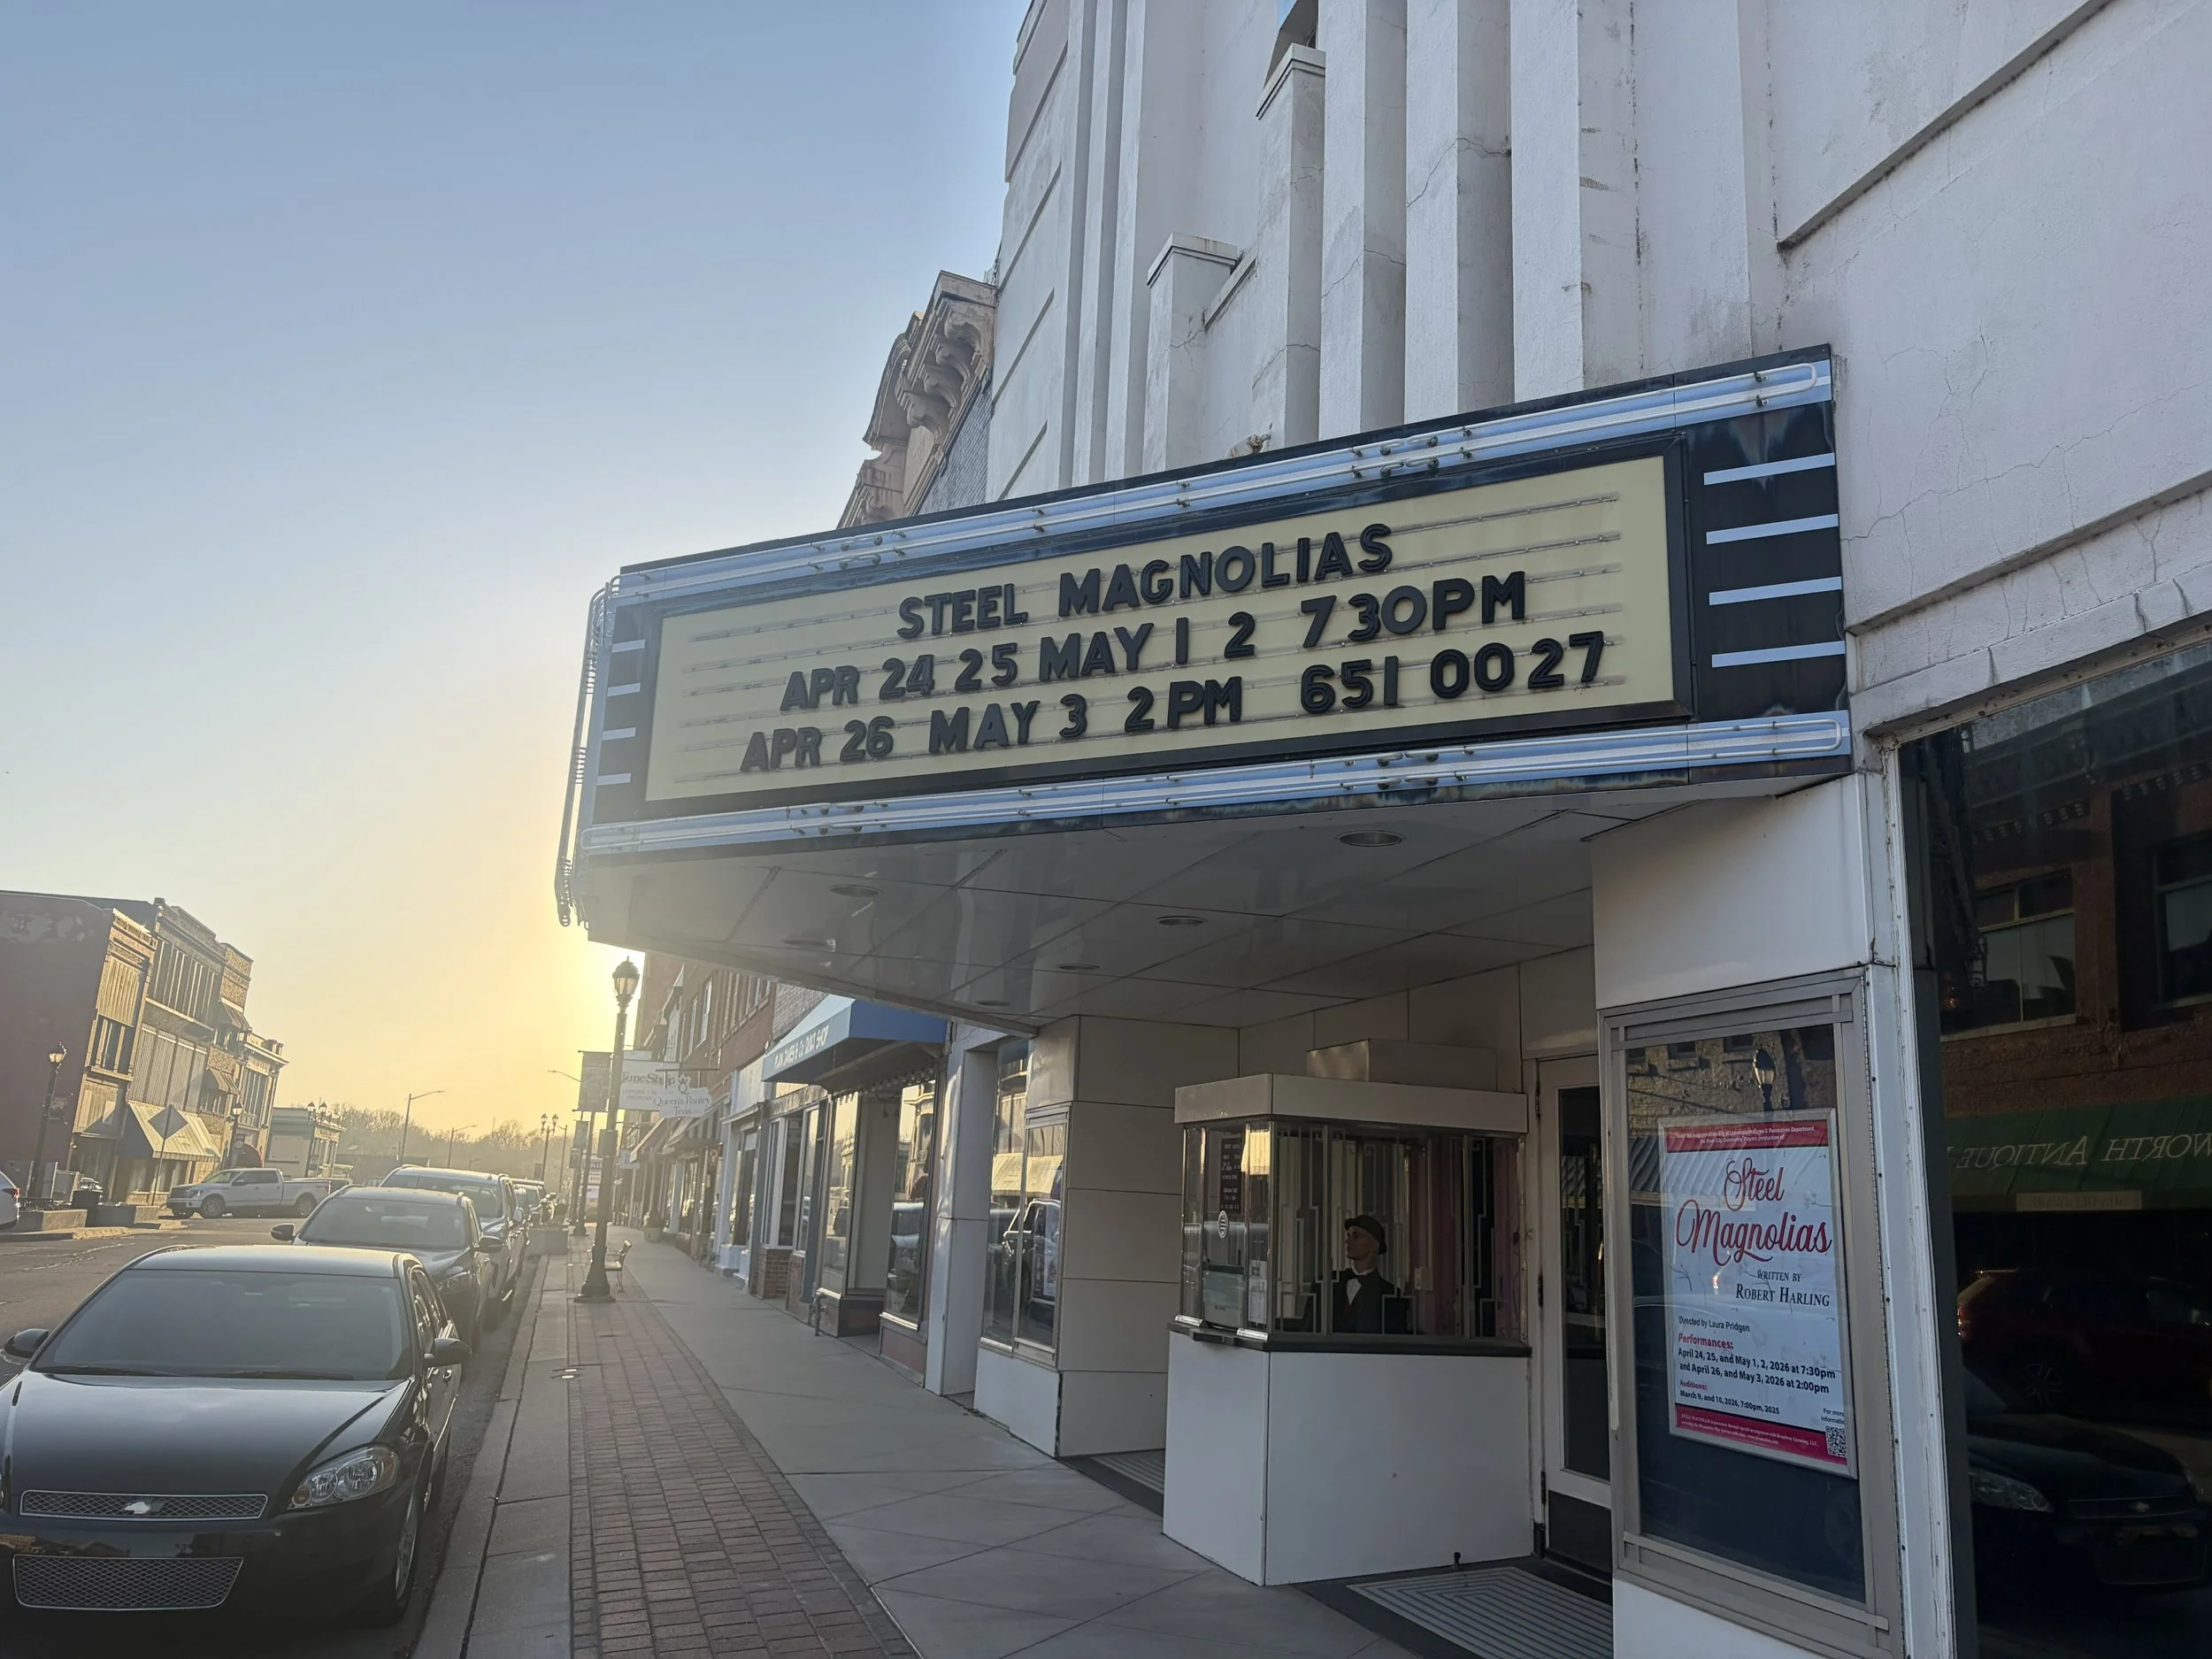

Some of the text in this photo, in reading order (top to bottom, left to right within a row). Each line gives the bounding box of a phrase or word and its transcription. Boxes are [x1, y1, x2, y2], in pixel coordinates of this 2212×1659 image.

[895, 523, 1393, 640] STEEL MAGNOLIAS
[780, 665, 860, 711] APR
[879, 654, 935, 701] 24
[958, 642, 1018, 692] 25
[1039, 623, 1153, 681] MAY
[1224, 611, 1256, 659] 2
[740, 726, 822, 773] APR
[839, 716, 895, 763] 26
[928, 700, 1042, 756] MAY
[1059, 694, 1087, 739] 3
[1300, 656, 1400, 713] 651
[1724, 1157, 1785, 1211] Steel
[1676, 1199, 1832, 1266] Magnolias
[1757, 1269, 1802, 1282] WRITTEN BY
[1678, 1316, 1750, 1333] Directed by Laura Pridgen
[1678, 1333, 1733, 1349] Performances:
[1678, 1348, 1836, 1379] April 24, 25, and May 1, 2, 2026 at 7:30pm
[1679, 1363, 1829, 1394] and April 26, and May 3, 2026 at 2:00pm
[1680, 1390, 1697, 1399] March
[1764, 1405, 1779, 1415] 2025
